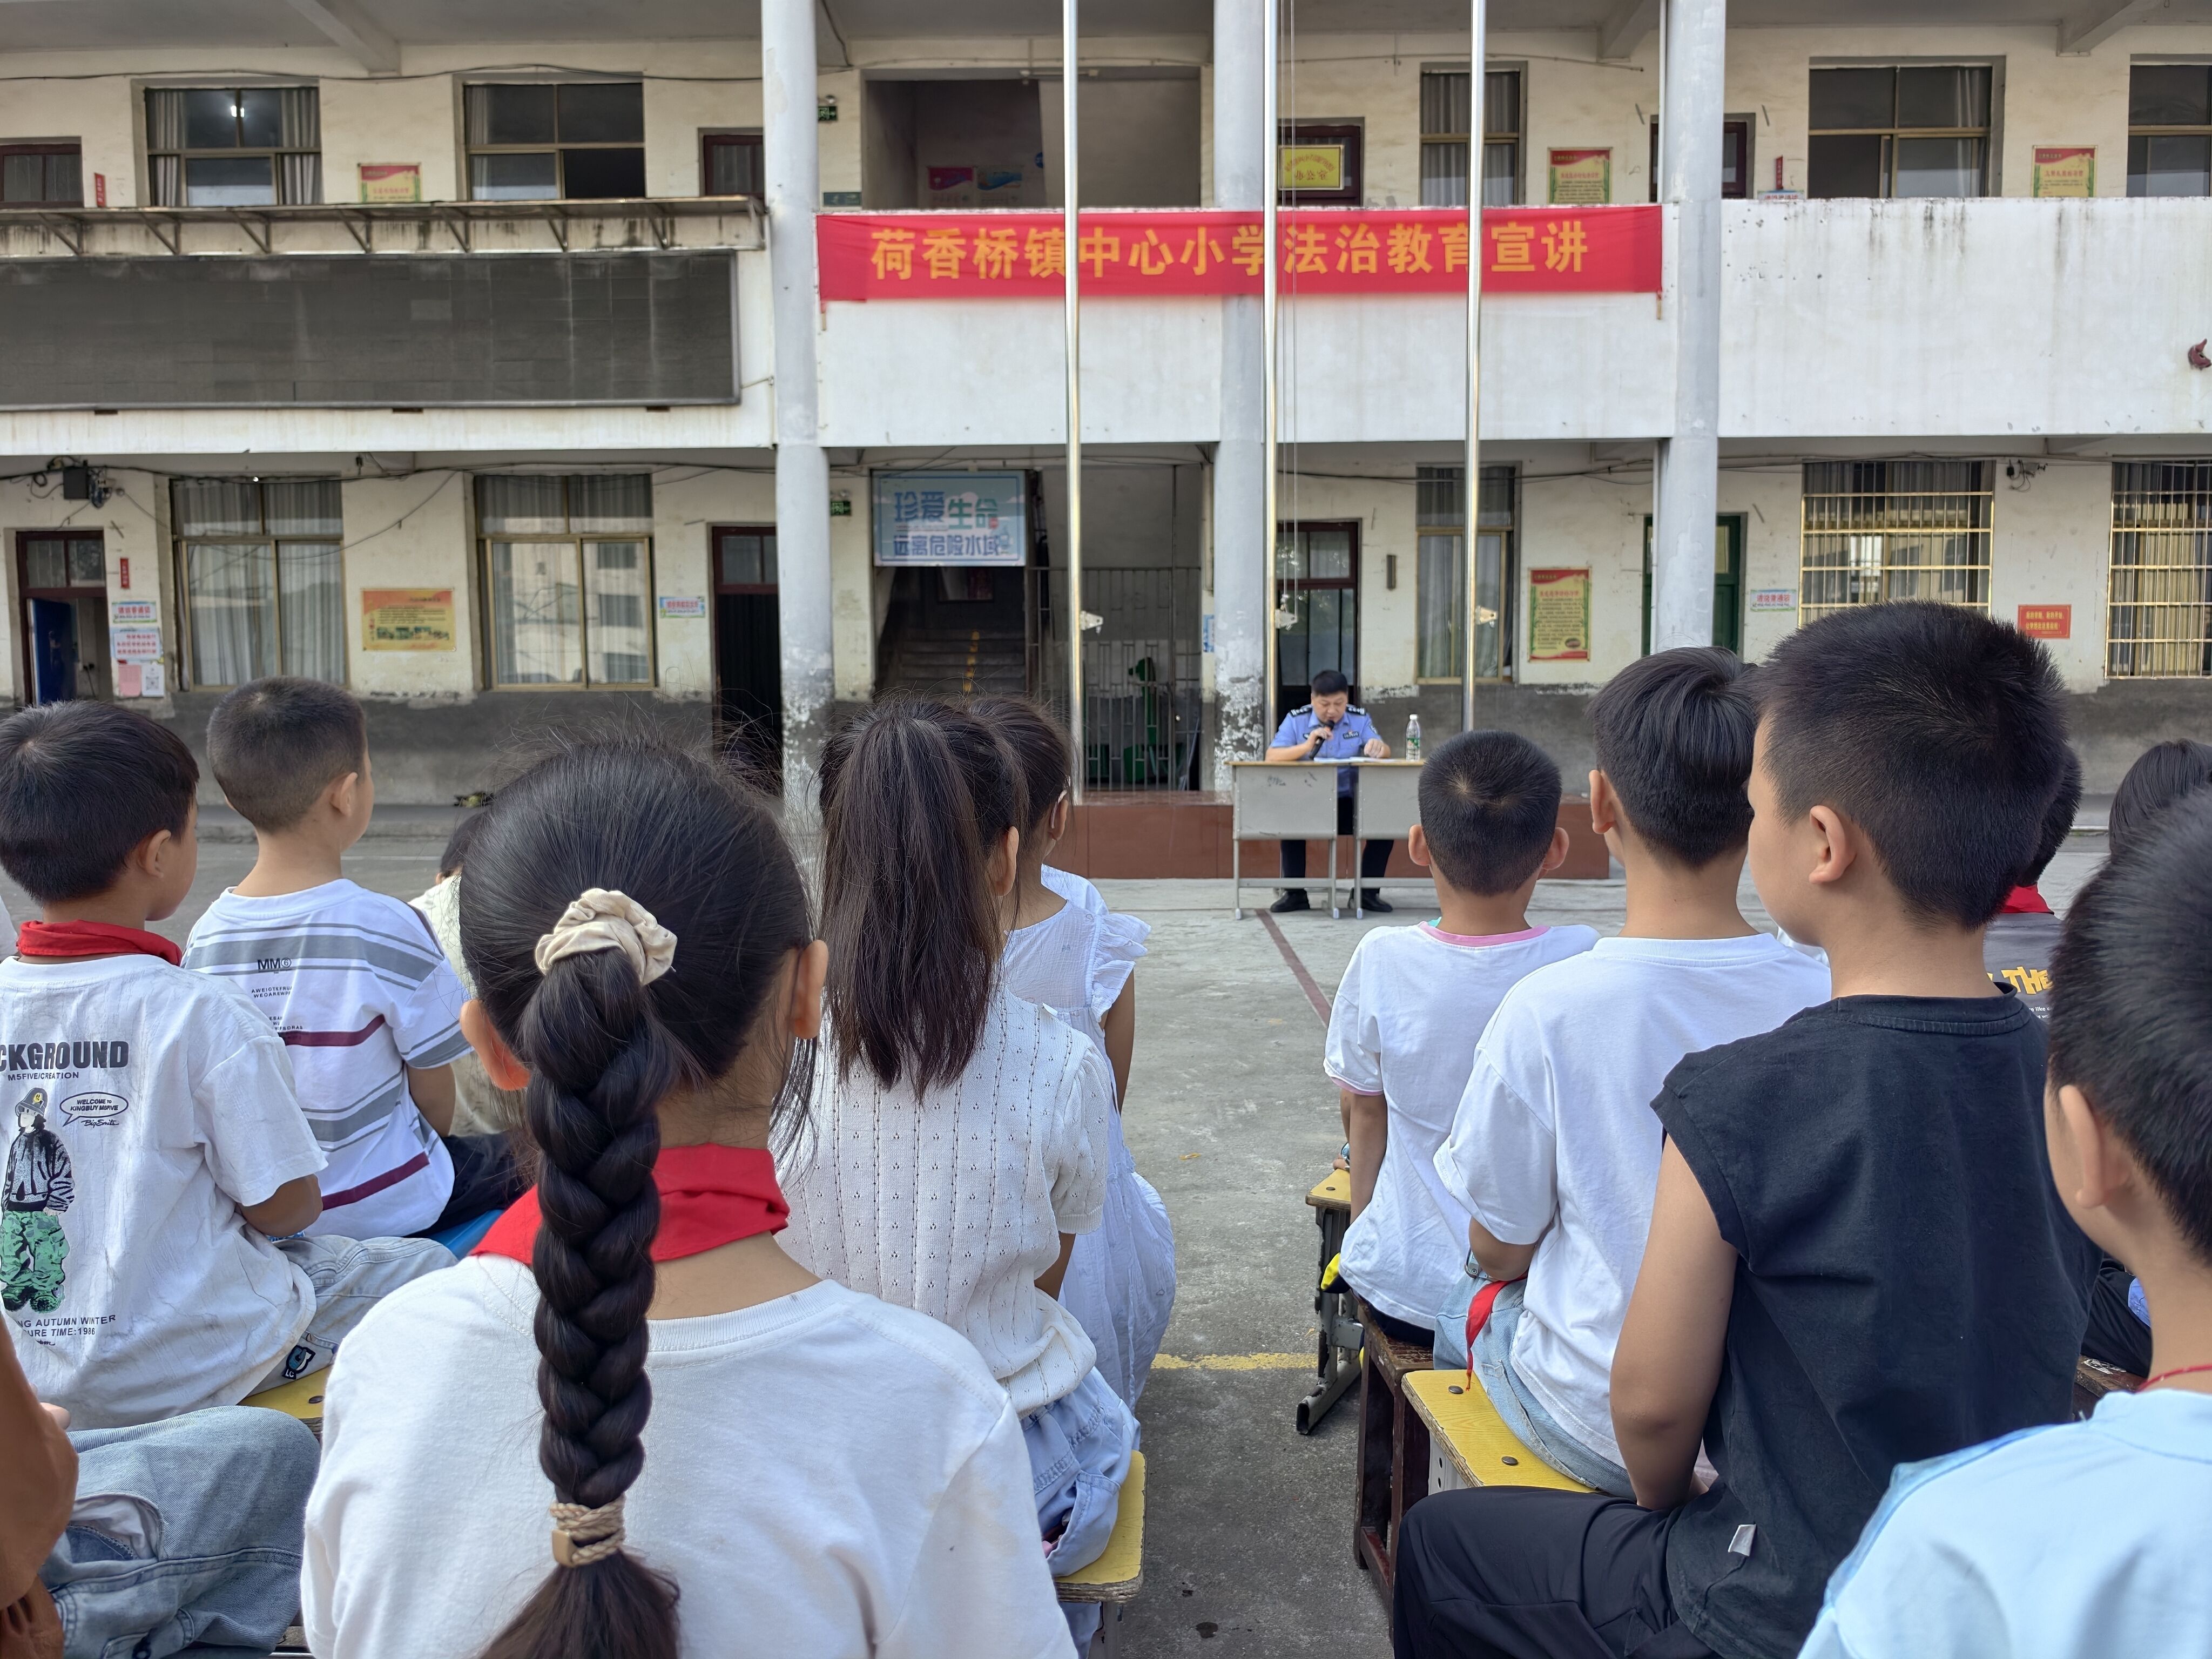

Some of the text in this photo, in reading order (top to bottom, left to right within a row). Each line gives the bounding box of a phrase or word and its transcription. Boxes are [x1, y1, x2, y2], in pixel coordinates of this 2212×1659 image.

[871, 221, 1588, 280] 荷香桥镇中心小学法治教育宣讲
[894, 491, 999, 529] 珍爱生命
[893, 535, 1000, 556] 远离危险水域
[2001, 966, 2053, 994] THE
[8, 1071, 79, 1081] M5FIVE/CREATION
[36, 1317, 77, 1326] AUTUMN
[81, 1314, 116, 1325] WINTER
[51, 1327, 95, 1336] TIME:1986
